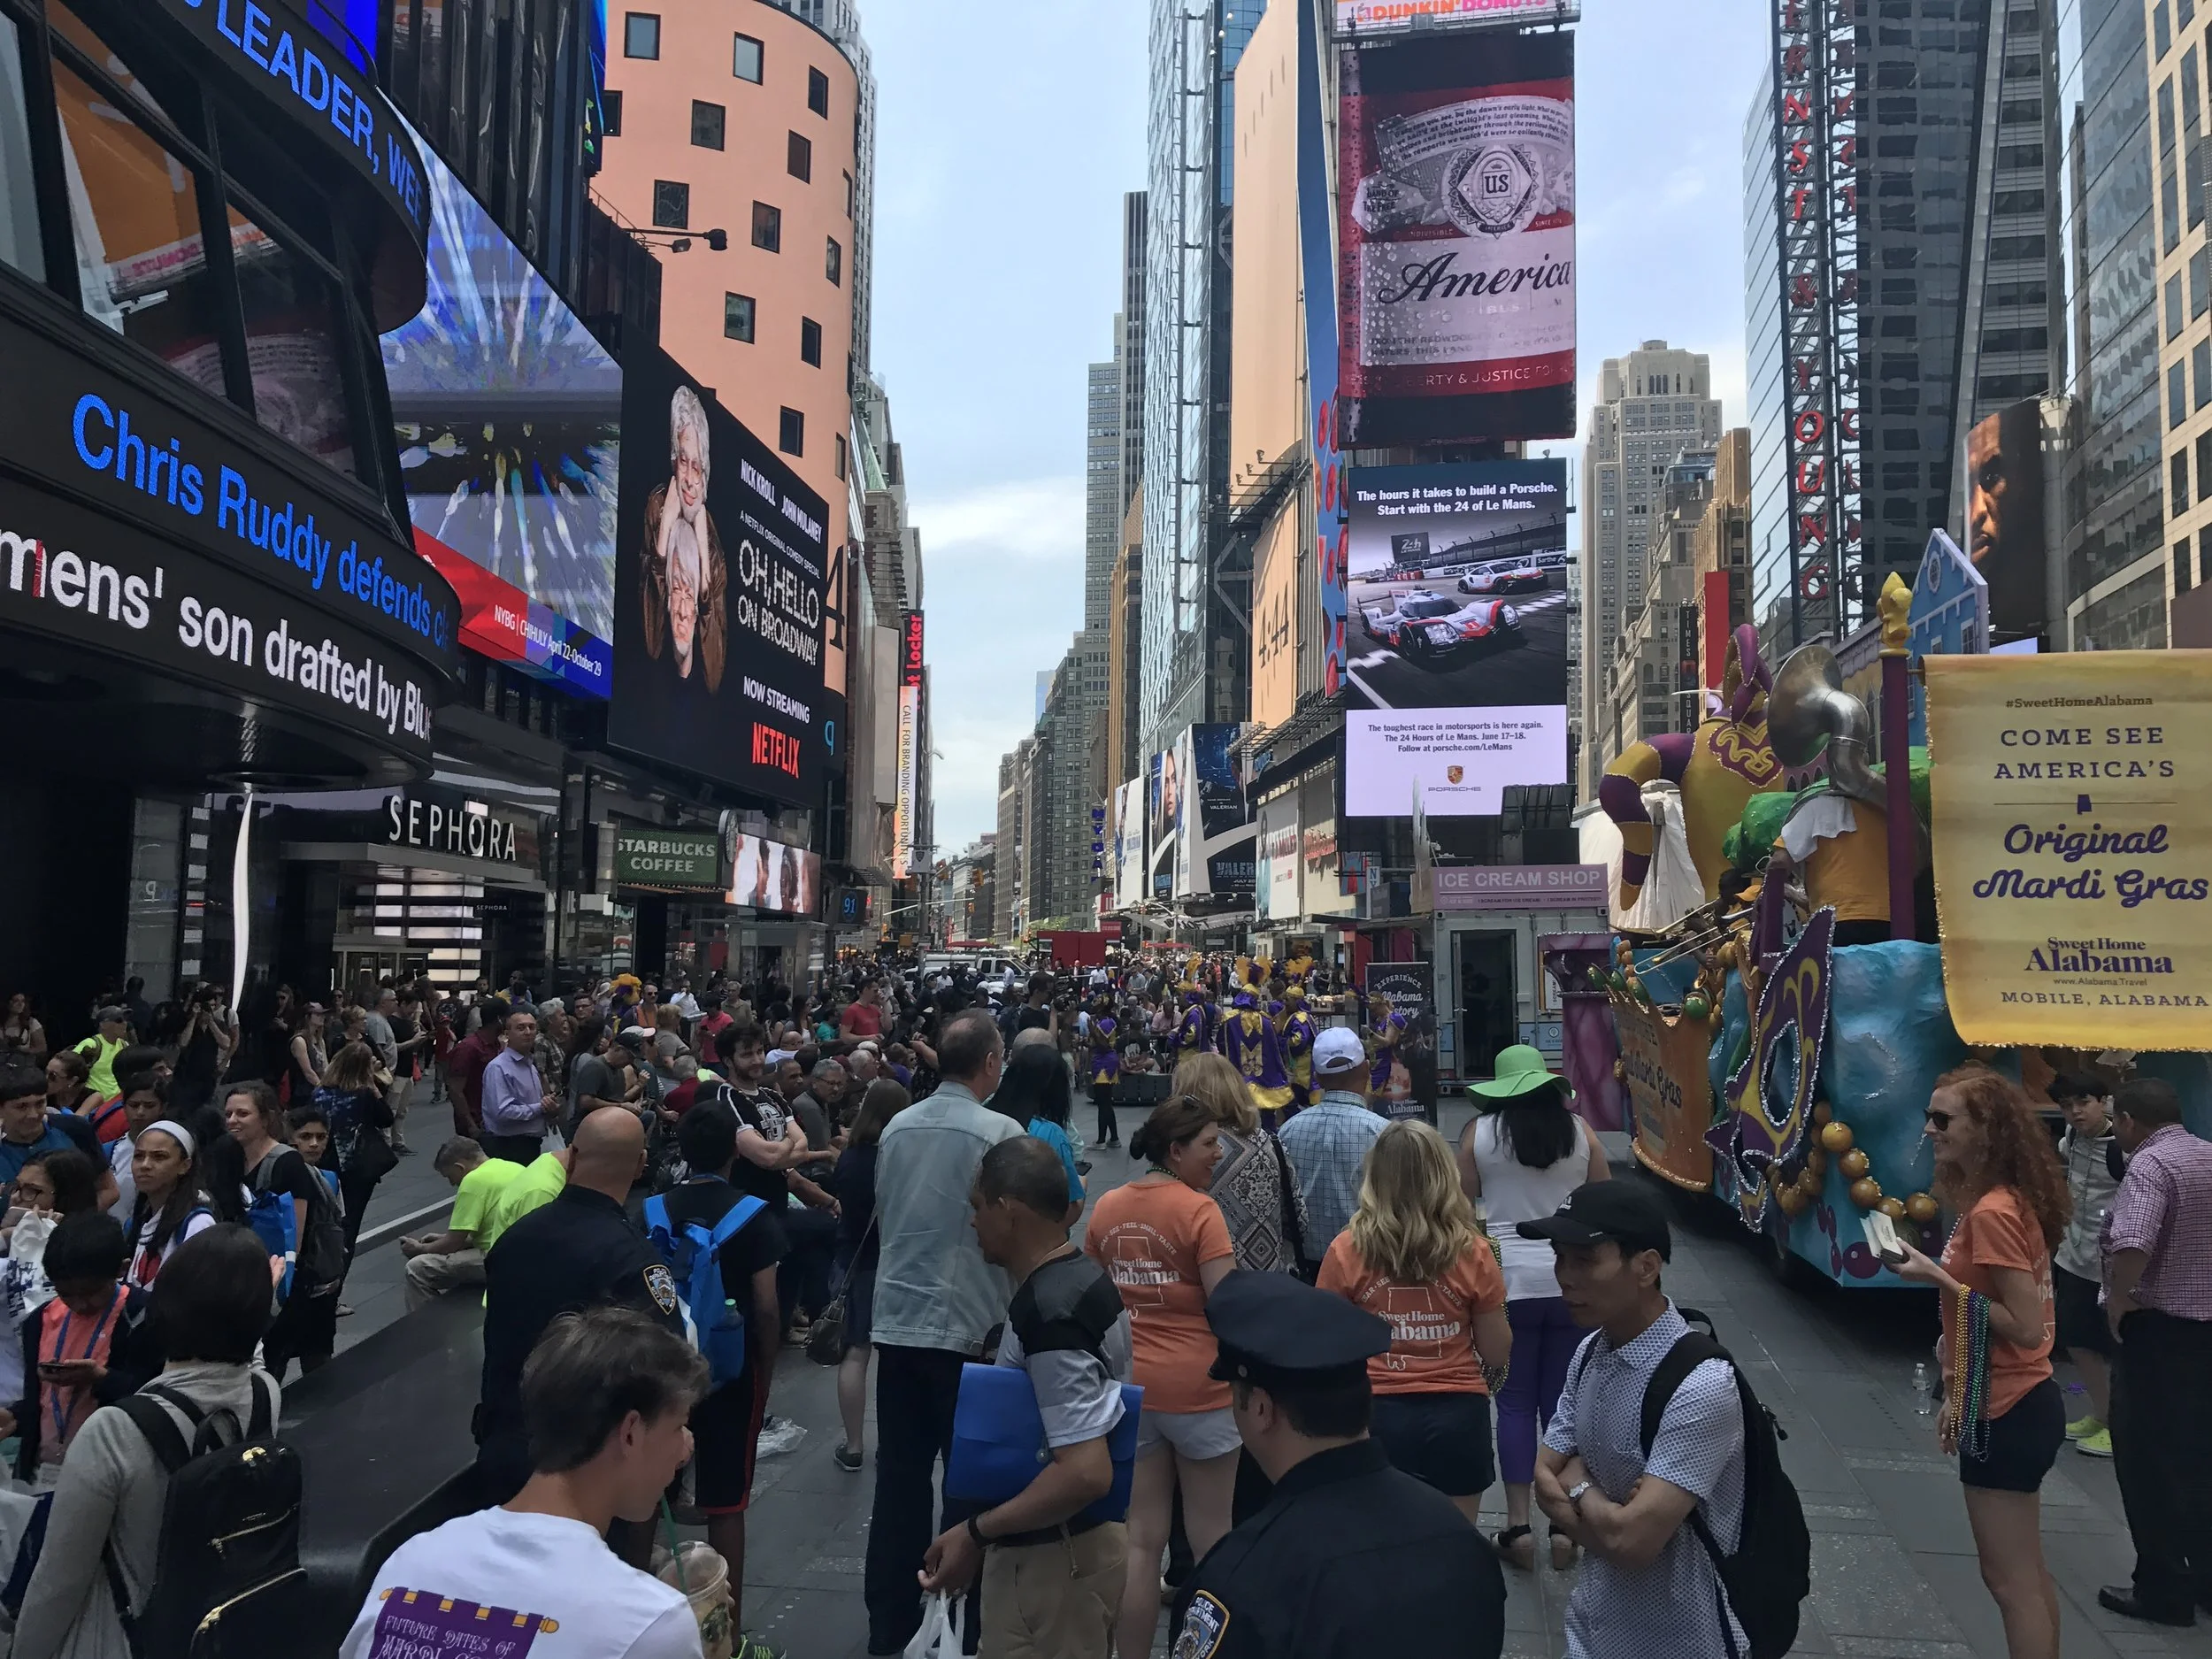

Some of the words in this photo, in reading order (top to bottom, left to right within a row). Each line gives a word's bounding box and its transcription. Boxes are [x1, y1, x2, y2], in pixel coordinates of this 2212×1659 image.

[217, 0, 379, 174] LEADER,
[1485, 174, 1509, 194] US
[1378, 251, 1571, 304] America
[1471, 367, 1530, 383] JUSTICE
[1356, 490, 1377, 502] The
[1379, 489, 1409, 501] hours
[1412, 488, 1421, 499] it
[1423, 488, 1453, 498] takes
[1455, 487, 1467, 496] to
[1470, 484, 1497, 496] build
[1509, 482, 1557, 494] Porsche.
[72, 394, 204, 516] Chris
[218, 465, 332, 590] Ruddy
[337, 540, 431, 637] defends
[1377, 504, 1405, 516] Start
[1408, 503, 1431, 514] with
[1433, 503, 1451, 513] the
[1454, 502, 1469, 512] 24
[1472, 501, 1484, 511] of
[1486, 500, 1500, 511] Le
[1502, 499, 1535, 510] Mans.
[739, 539, 772, 607] OH,
[774, 560, 819, 629] HELLO
[495, 604, 516, 631] NYBG
[548, 635, 562, 657] April
[594, 661, 602, 677] 29
[738, 595, 758, 632] ON
[761, 607, 818, 666] BROADWAY
[906, 615, 922, 669] Locker
[178, 595, 254, 666] son
[265, 619, 372, 711] drafted
[376, 664, 402, 735] by
[743, 675, 766, 703] NOW
[766, 687, 810, 724] STREAMING
[2005, 695, 2154, 709] #SweetHomeAlabama
[902, 704, 911, 726] CALL
[1383, 723, 1416, 733] toughest
[1445, 722, 1491, 732] motorsports
[1520, 721, 1543, 730] again.
[1436, 733, 1444, 741] of
[1481, 732, 1499, 741] June
[2001, 727, 2092, 747] COME
[2106, 726, 2164, 744] SEE
[752, 721, 801, 780] NETFLIX
[1398, 744, 1421, 753] Follow
[1432, 743, 1513, 753] porsche.com/LeMans
[901, 747, 910, 795] BRANDING
[1993, 759, 2175, 780] AMERICA'S
[389, 795, 517, 862] SEPHORA
[618, 839, 716, 857] STARBUCKS
[2004, 823, 2170, 864] Original
[630, 856, 695, 872] COFFEE
[1216, 862, 1256, 876] VALER
[1438, 872, 1470, 887] ICE
[1475, 872, 1541, 887] CREAM
[1548, 871, 1601, 886] SHOP
[1972, 869, 2106, 901] Mardi
[2113, 869, 2208, 909] Gras
[2047, 936, 2094, 950] Sweet
[2097, 936, 2147, 950] Home
[2024, 947, 2175, 973] Alabama
[1374, 974, 1422, 990] EXPERIENCE
[2001, 991, 2091, 1007] MOBILE,
[2099, 993, 2208, 1007] ALABAMA
[1386, 1103, 1425, 1115] Alabama
[1112, 1256, 1137, 1268] Sweet
[1137, 1257, 1163, 1268] Home
[1378, 1310, 1410, 1322] Sweet
[1411, 1310, 1445, 1322] Home
[1391, 1321, 1461, 1341] abama
[1195, 1597, 1215, 1615] POLICE
[380, 1615, 439, 1643] FUTURE
[442, 1630, 491, 1653] DATES
[495, 1641, 517, 1659] OF
